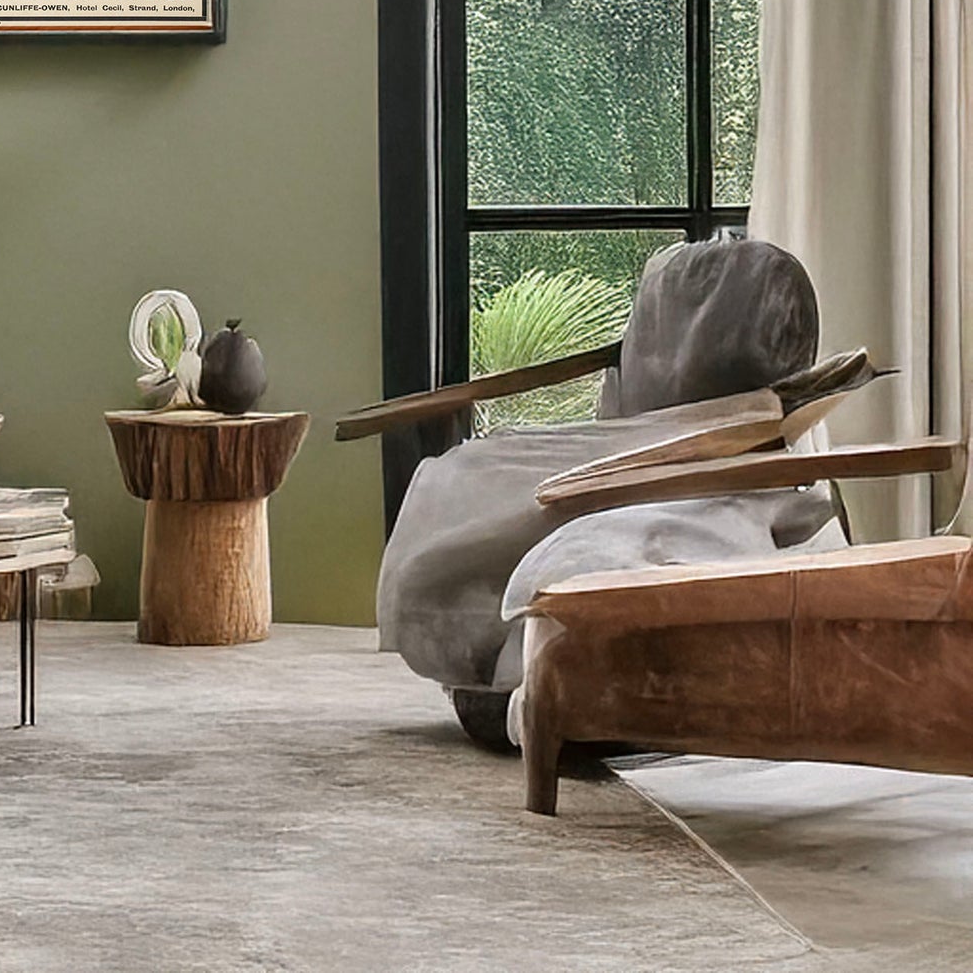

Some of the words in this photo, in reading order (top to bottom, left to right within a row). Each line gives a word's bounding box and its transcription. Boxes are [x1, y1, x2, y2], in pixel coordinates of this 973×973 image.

[76, 4, 98, 12] Hotel
[101, 4, 125, 12] Cecil,
[128, 4, 159, 12] Strand,
[163, 4, 195, 13] London,
